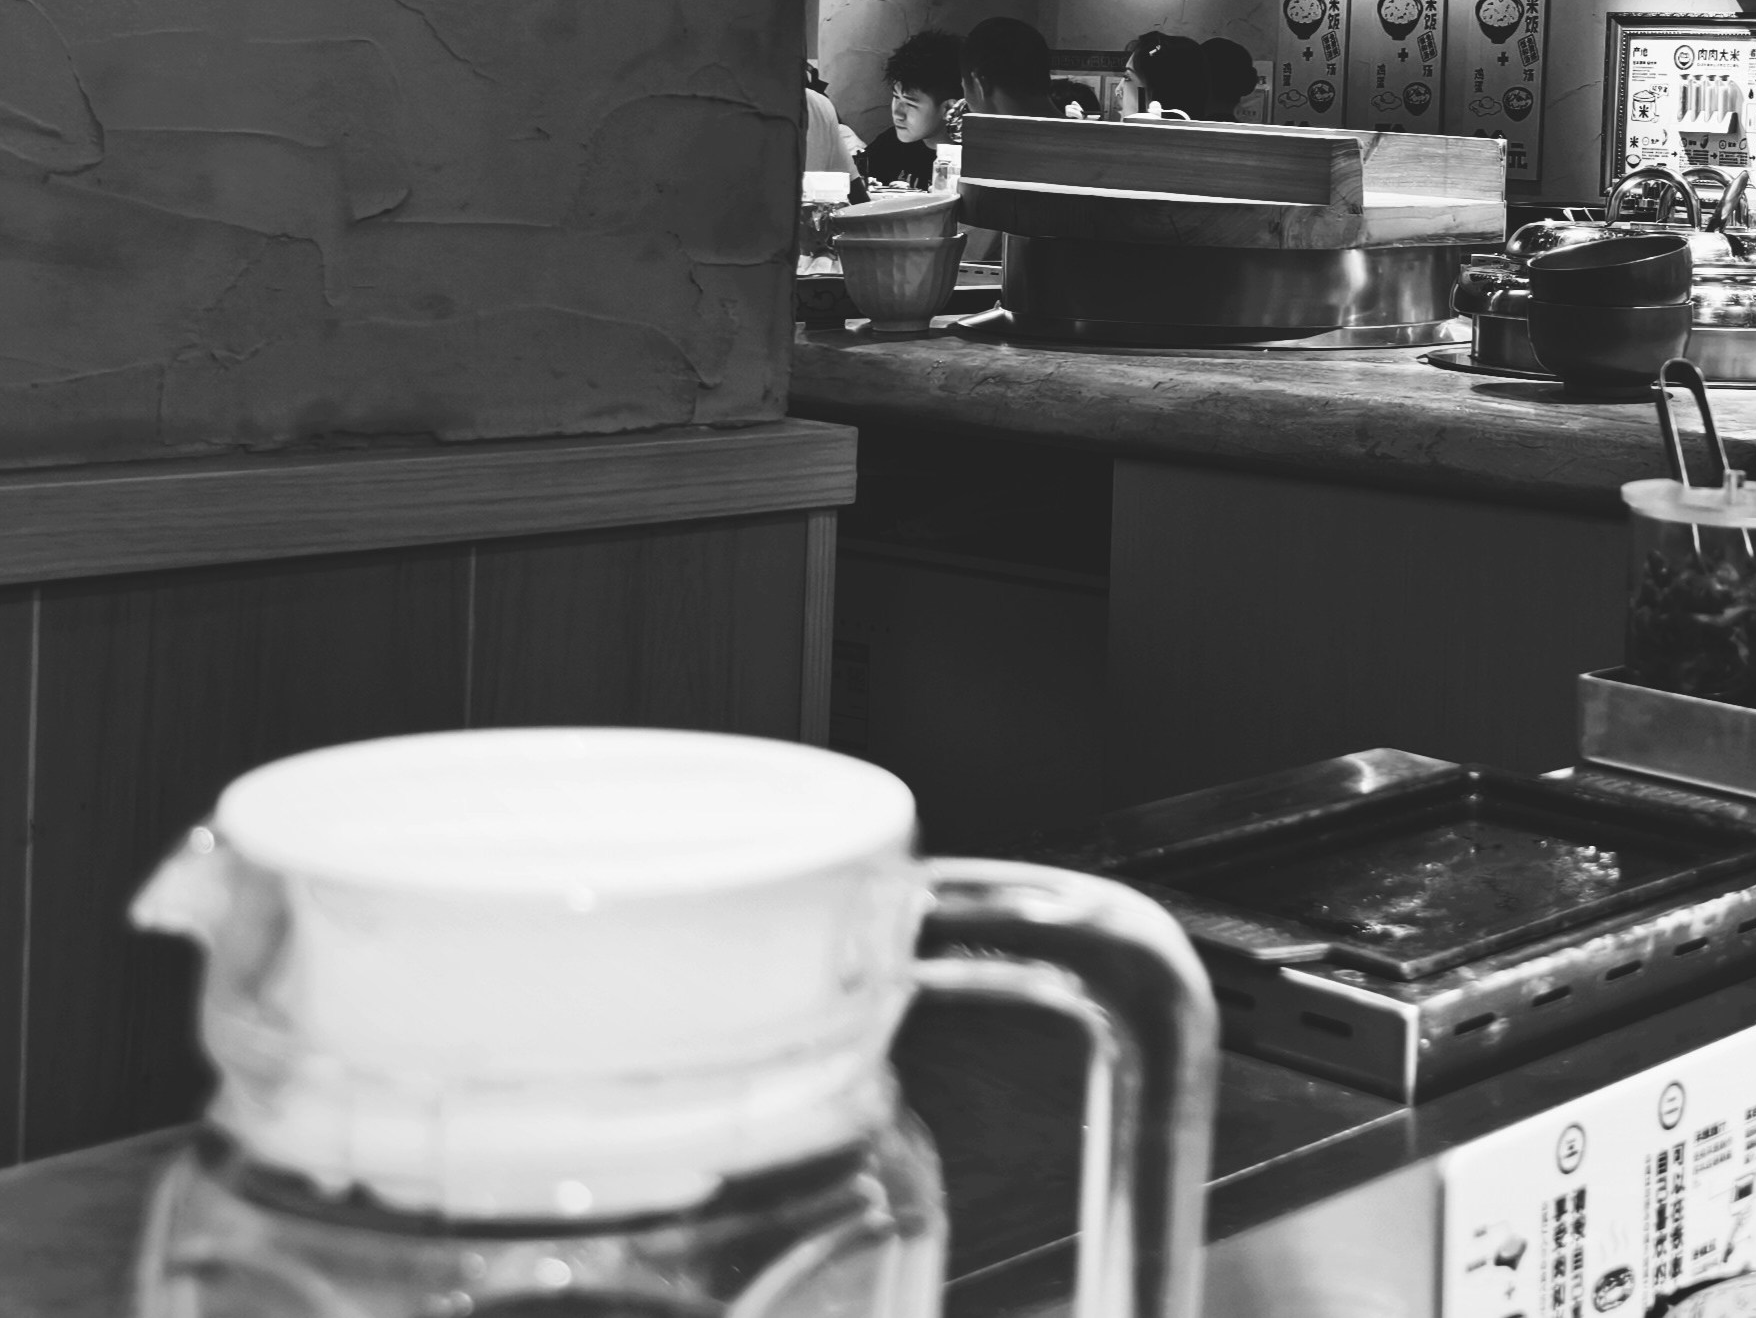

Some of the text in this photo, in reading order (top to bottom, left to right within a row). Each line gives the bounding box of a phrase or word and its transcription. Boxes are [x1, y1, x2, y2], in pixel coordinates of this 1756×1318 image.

[1697, 48, 1740, 62] 肉肉大米
[1639, 104, 1649, 119] 米
[1629, 135, 1639, 149] 米
